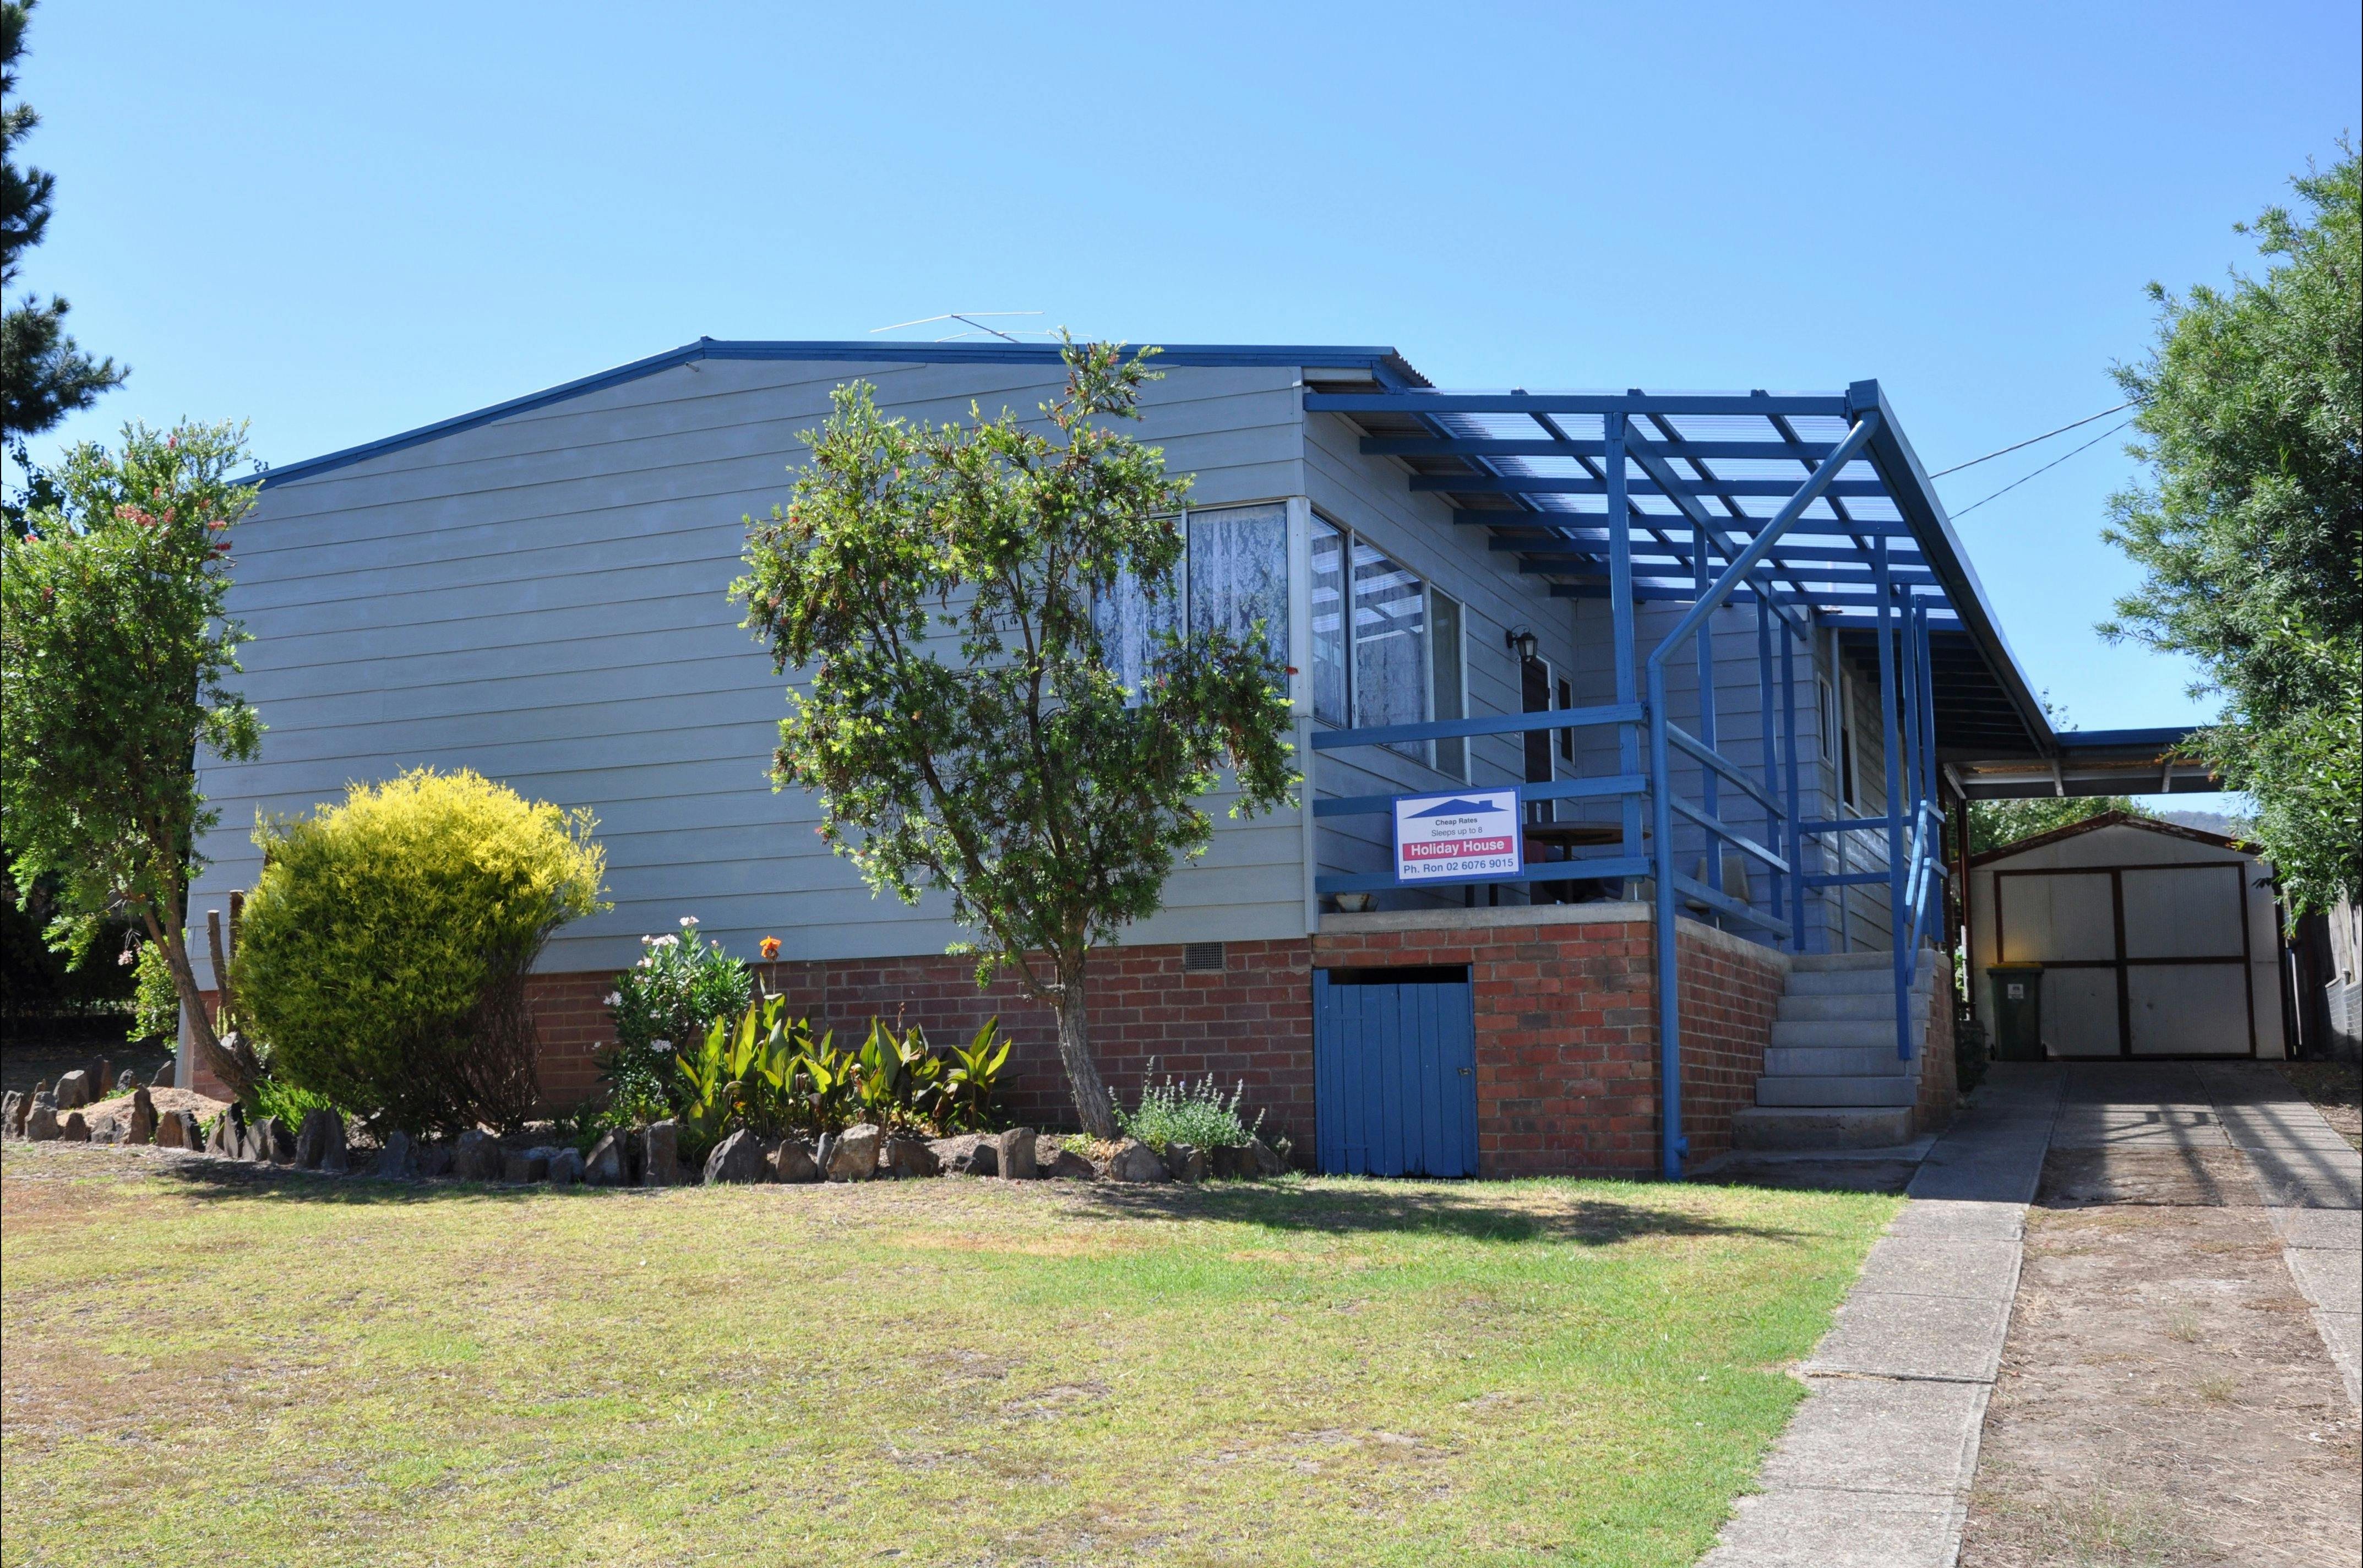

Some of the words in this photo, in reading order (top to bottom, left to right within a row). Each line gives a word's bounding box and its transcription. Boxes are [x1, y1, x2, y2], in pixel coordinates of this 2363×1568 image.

[1411, 843, 1459, 856] Holiday
[1463, 840, 1505, 852] House
[1424, 864, 1443, 873] Ron
[1462, 861, 1485, 870] 6076
[1489, 858, 1513, 868] 9015
